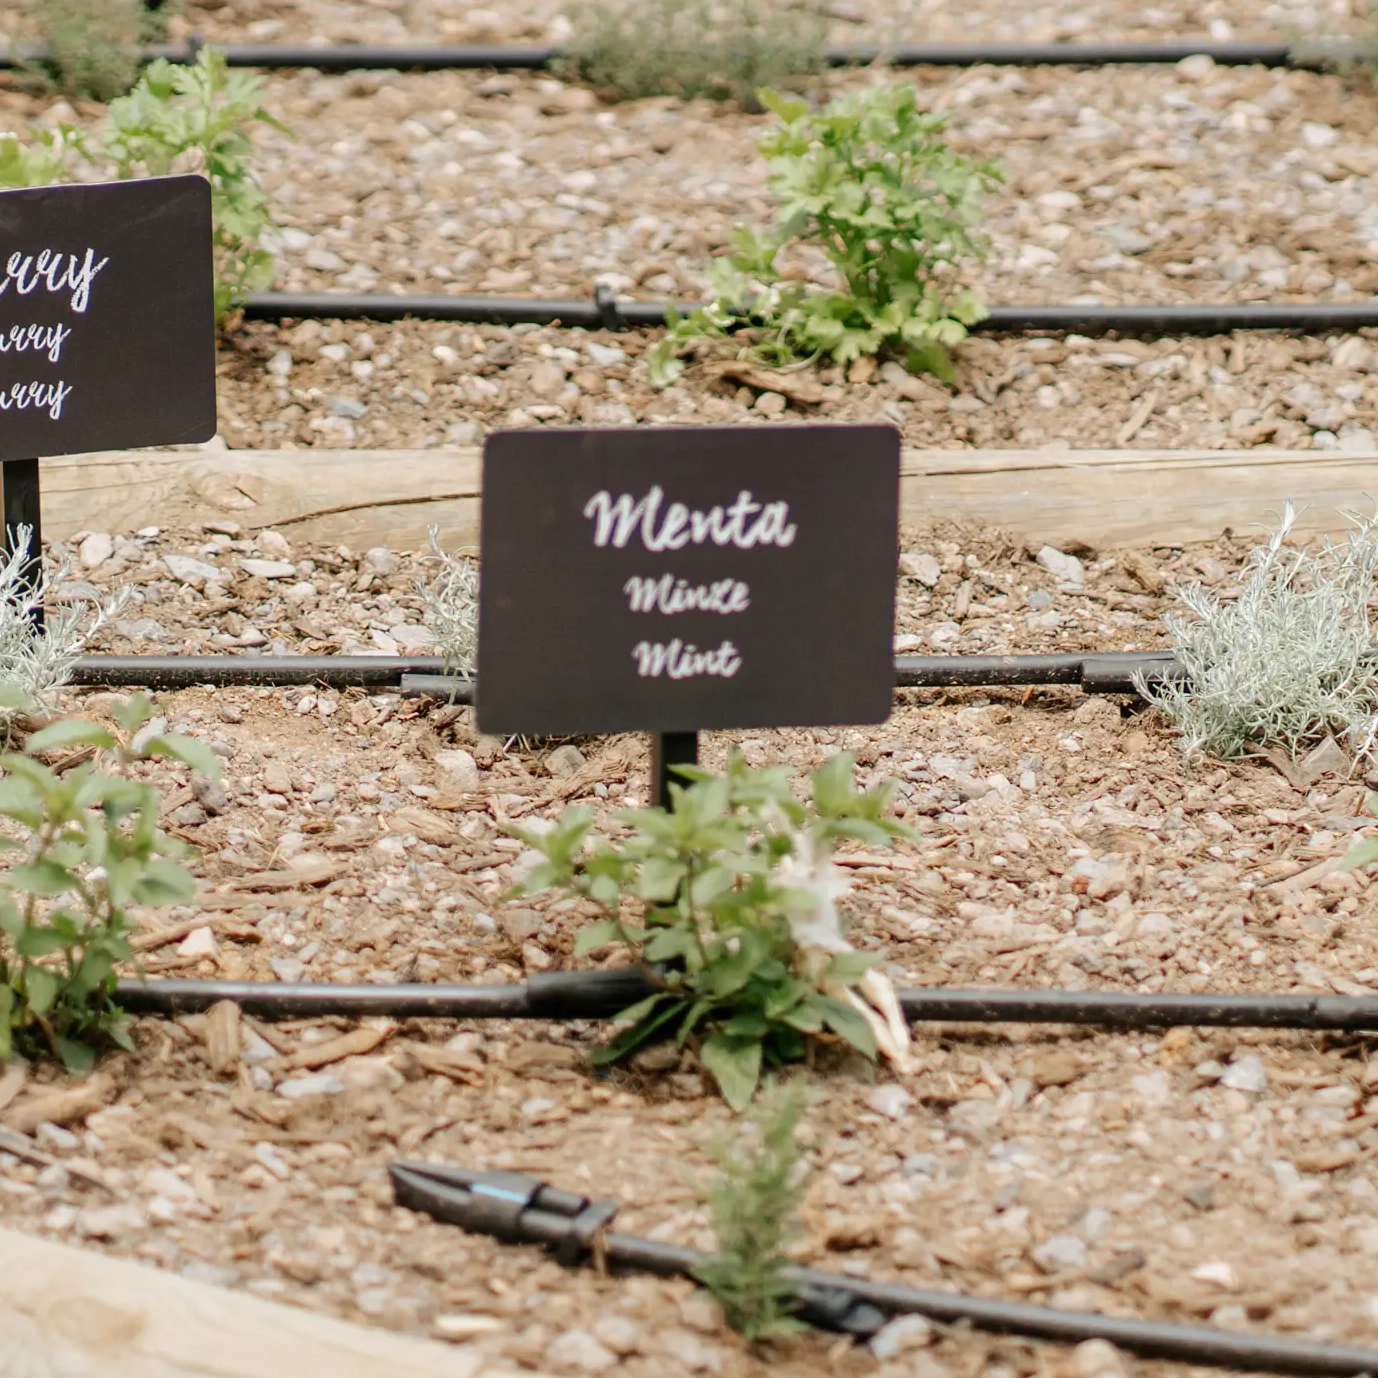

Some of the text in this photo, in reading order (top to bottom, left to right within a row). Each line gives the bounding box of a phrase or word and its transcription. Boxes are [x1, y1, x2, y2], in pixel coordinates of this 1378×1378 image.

[583, 485, 798, 553] Menta
[623, 573, 751, 615] Minze
[632, 638, 742, 680] Mint
